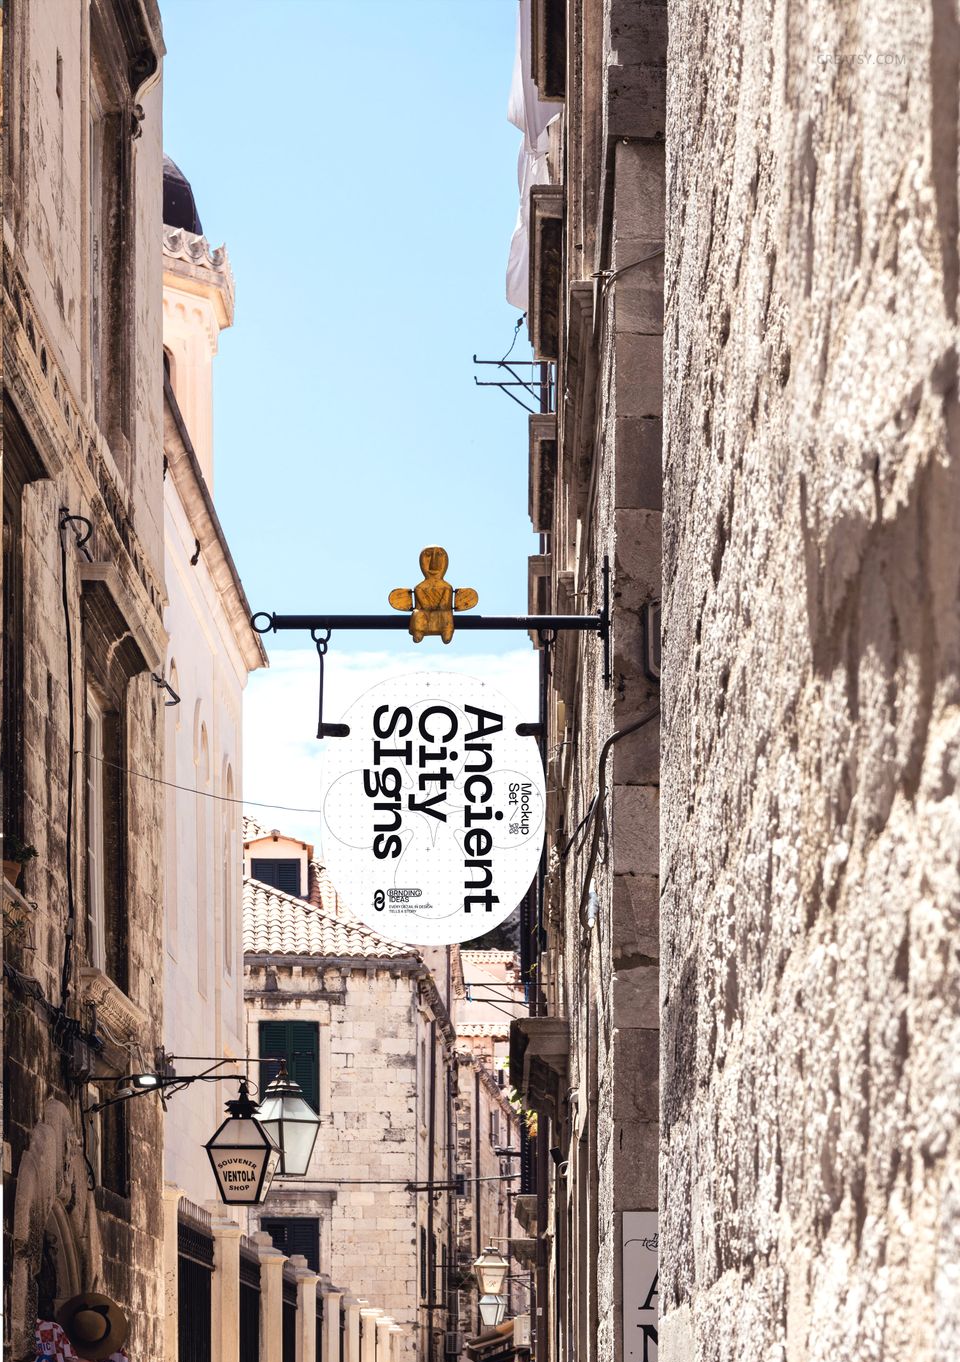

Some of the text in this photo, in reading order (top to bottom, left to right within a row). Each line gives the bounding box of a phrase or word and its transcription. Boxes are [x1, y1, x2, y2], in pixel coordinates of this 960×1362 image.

[408, 705, 458, 823] City
[463, 704, 504, 913] Ancient
[508, 783, 520, 806] Set
[519, 783, 532, 835] Mockup
[217, 1158, 257, 1170] SOUVENIR
[222, 1170, 256, 1182] VENTOLA
